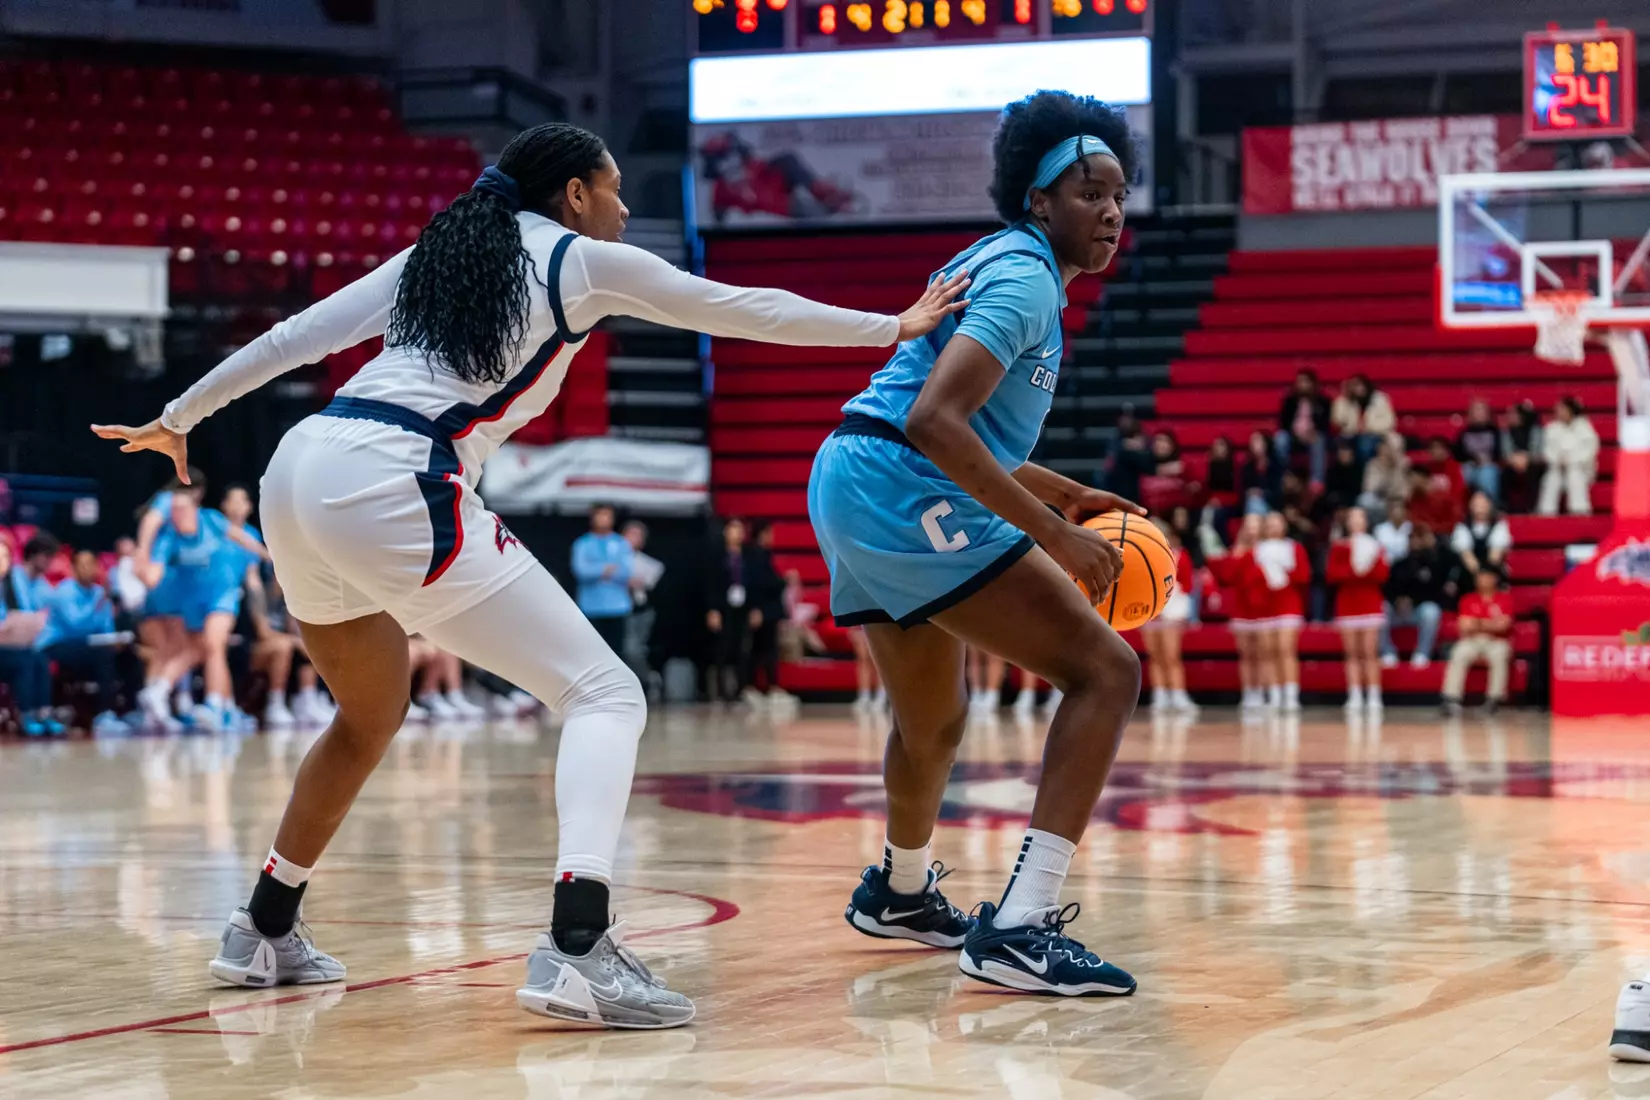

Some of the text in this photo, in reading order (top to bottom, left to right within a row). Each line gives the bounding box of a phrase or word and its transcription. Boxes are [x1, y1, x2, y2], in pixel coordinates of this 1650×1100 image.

[1549, 74, 1610, 128] 24
[1293, 135, 1497, 186] SEAWOLVES
[921, 499, 971, 552] C
